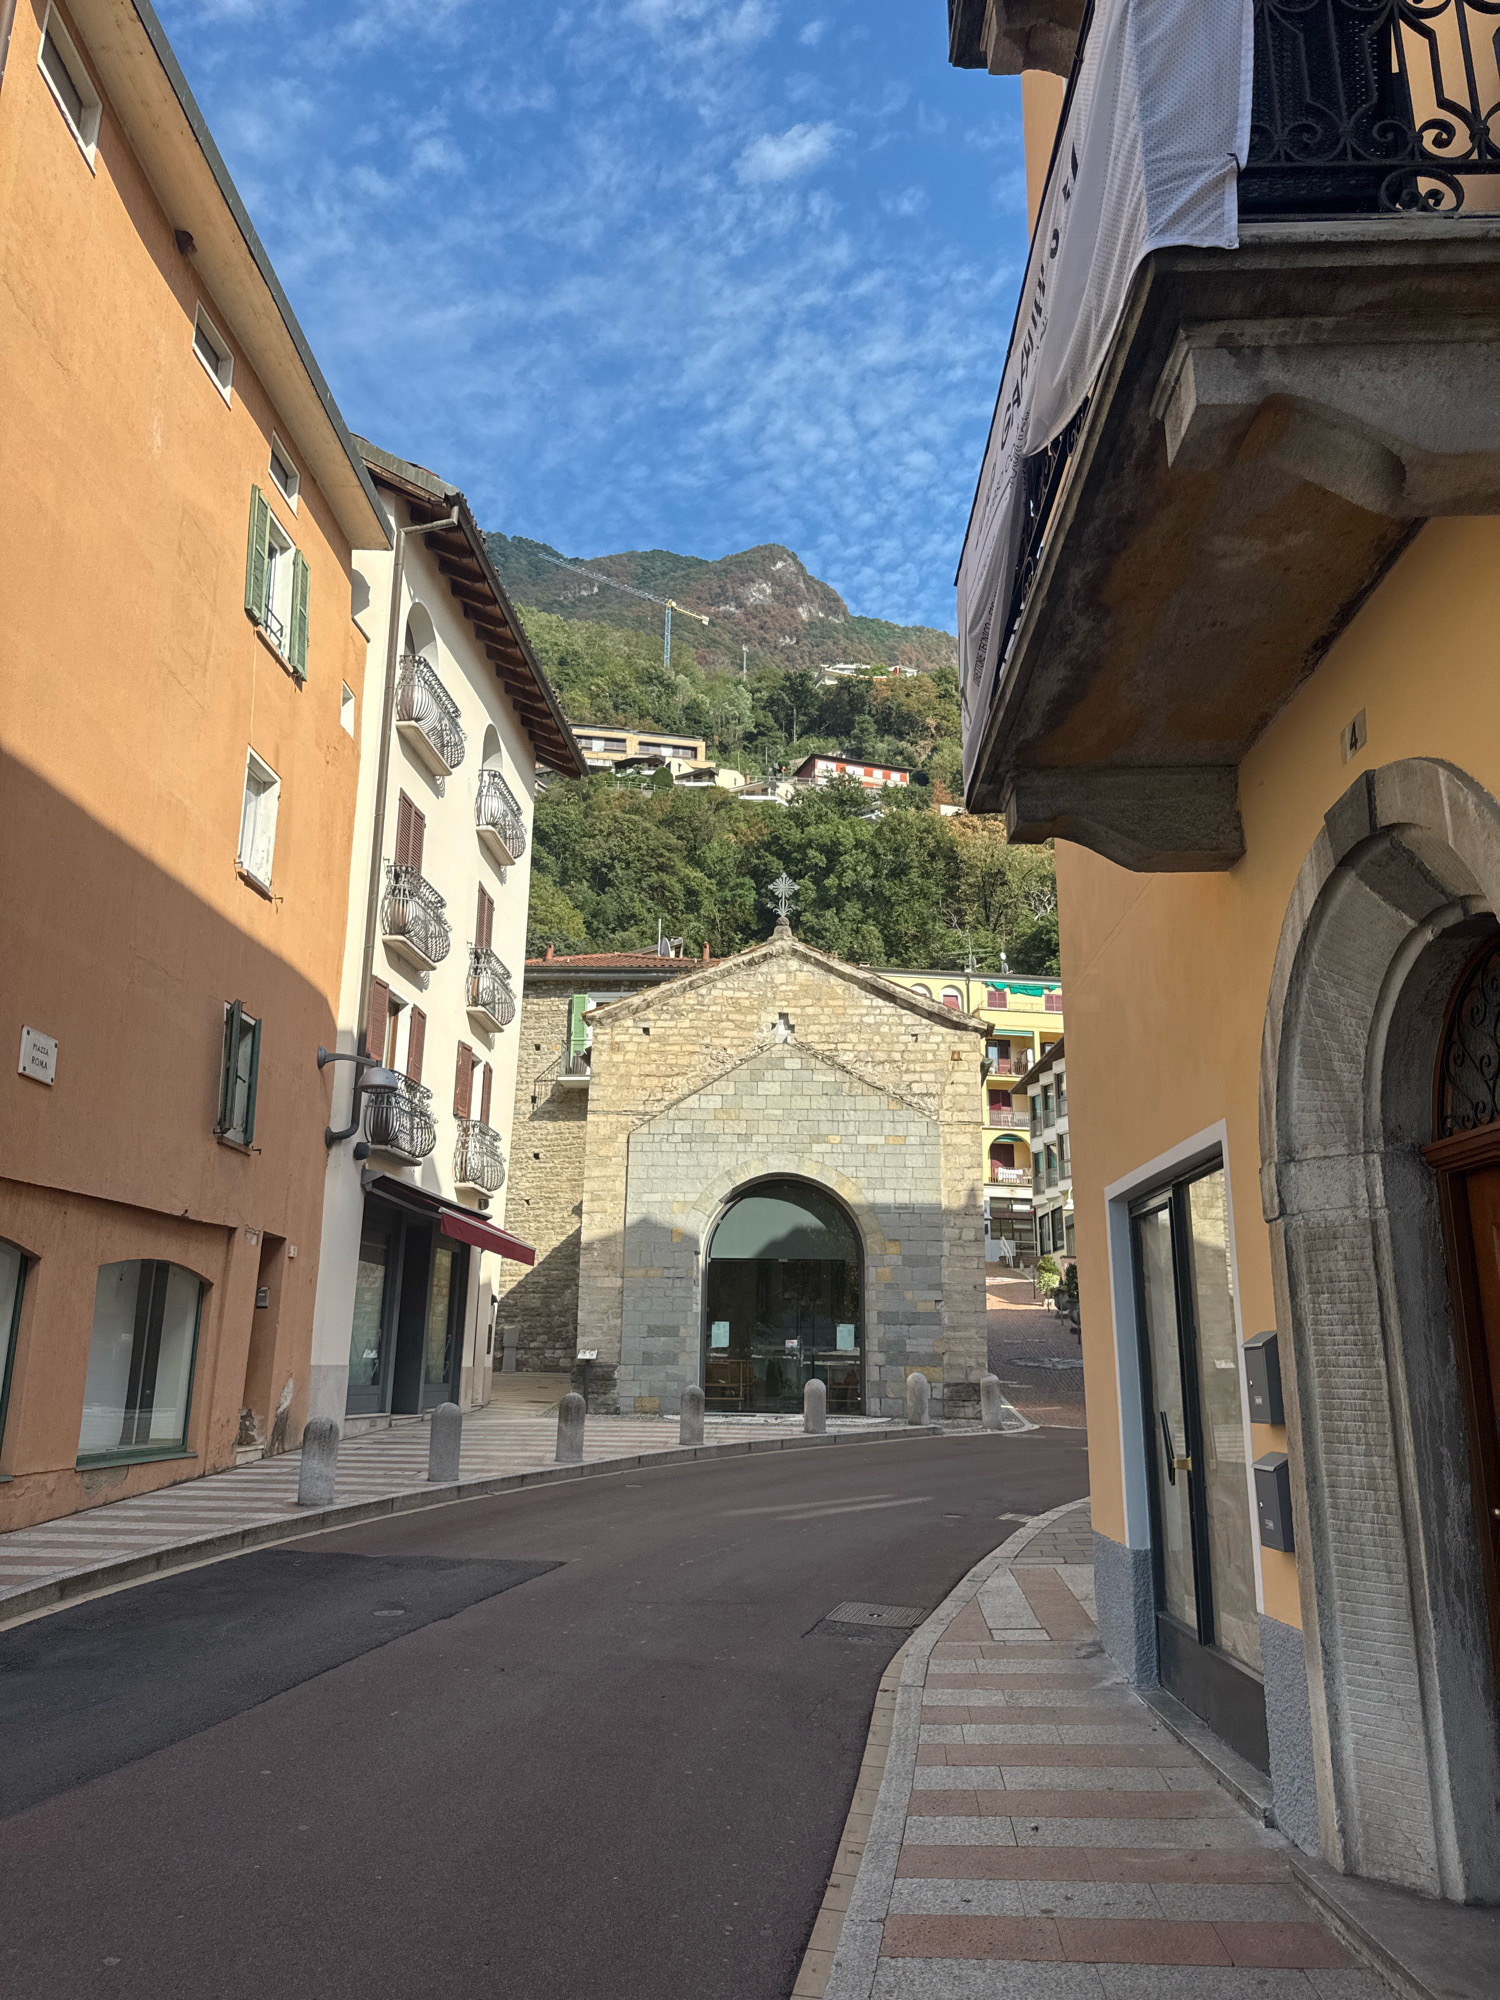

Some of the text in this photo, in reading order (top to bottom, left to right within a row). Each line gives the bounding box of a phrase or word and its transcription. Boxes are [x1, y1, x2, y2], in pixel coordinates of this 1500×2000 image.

[1350, 722, 1358, 750] 4
[32, 1043, 48, 1056] PIAZZA
[32, 1056, 48, 1070] ROMA
